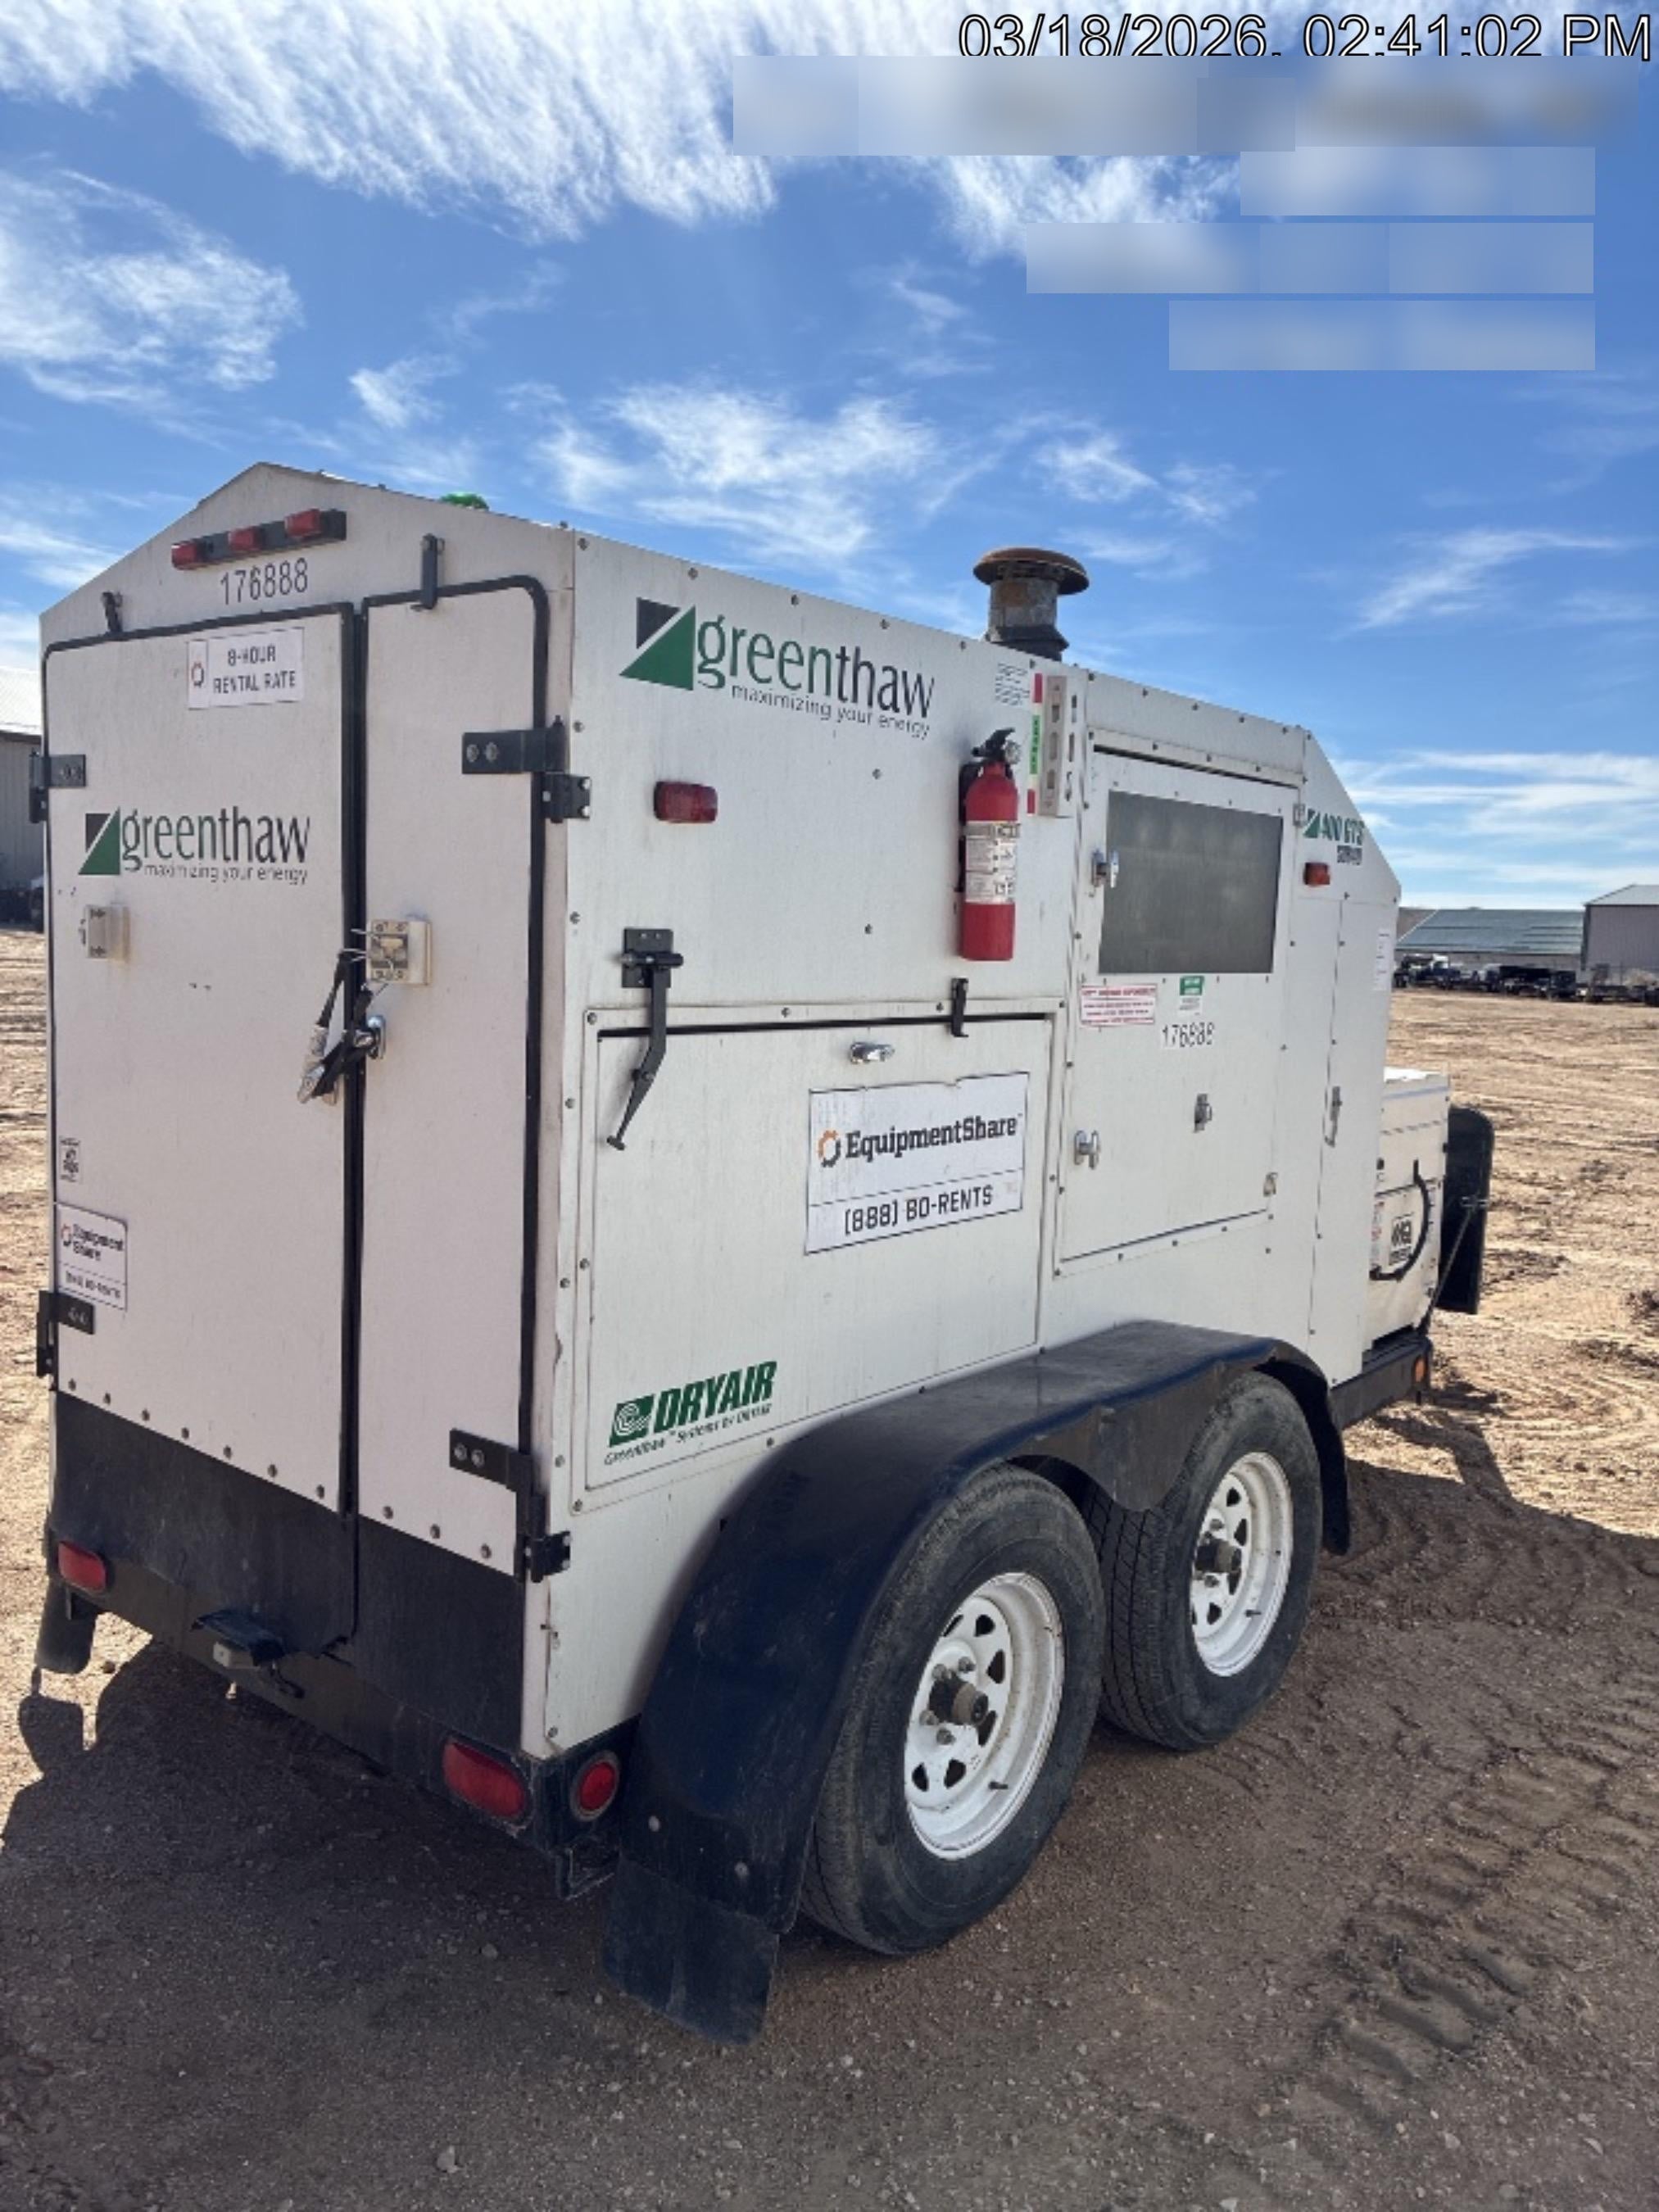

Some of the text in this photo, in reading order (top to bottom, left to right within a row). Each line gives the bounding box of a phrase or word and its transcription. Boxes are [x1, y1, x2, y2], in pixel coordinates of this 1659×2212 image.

[220, 557, 308, 605] 176888
[213, 670, 296, 694] RENTAL RATE
[697, 614, 935, 718] greenthaw
[732, 684, 931, 740] maximizing your energy
[122, 806, 310, 873] greenthaw
[144, 863, 307, 886] maximizing your energy
[845, 1115, 1017, 1162] EquipmentShare
[654, 1360, 777, 1434] DRYAIR
